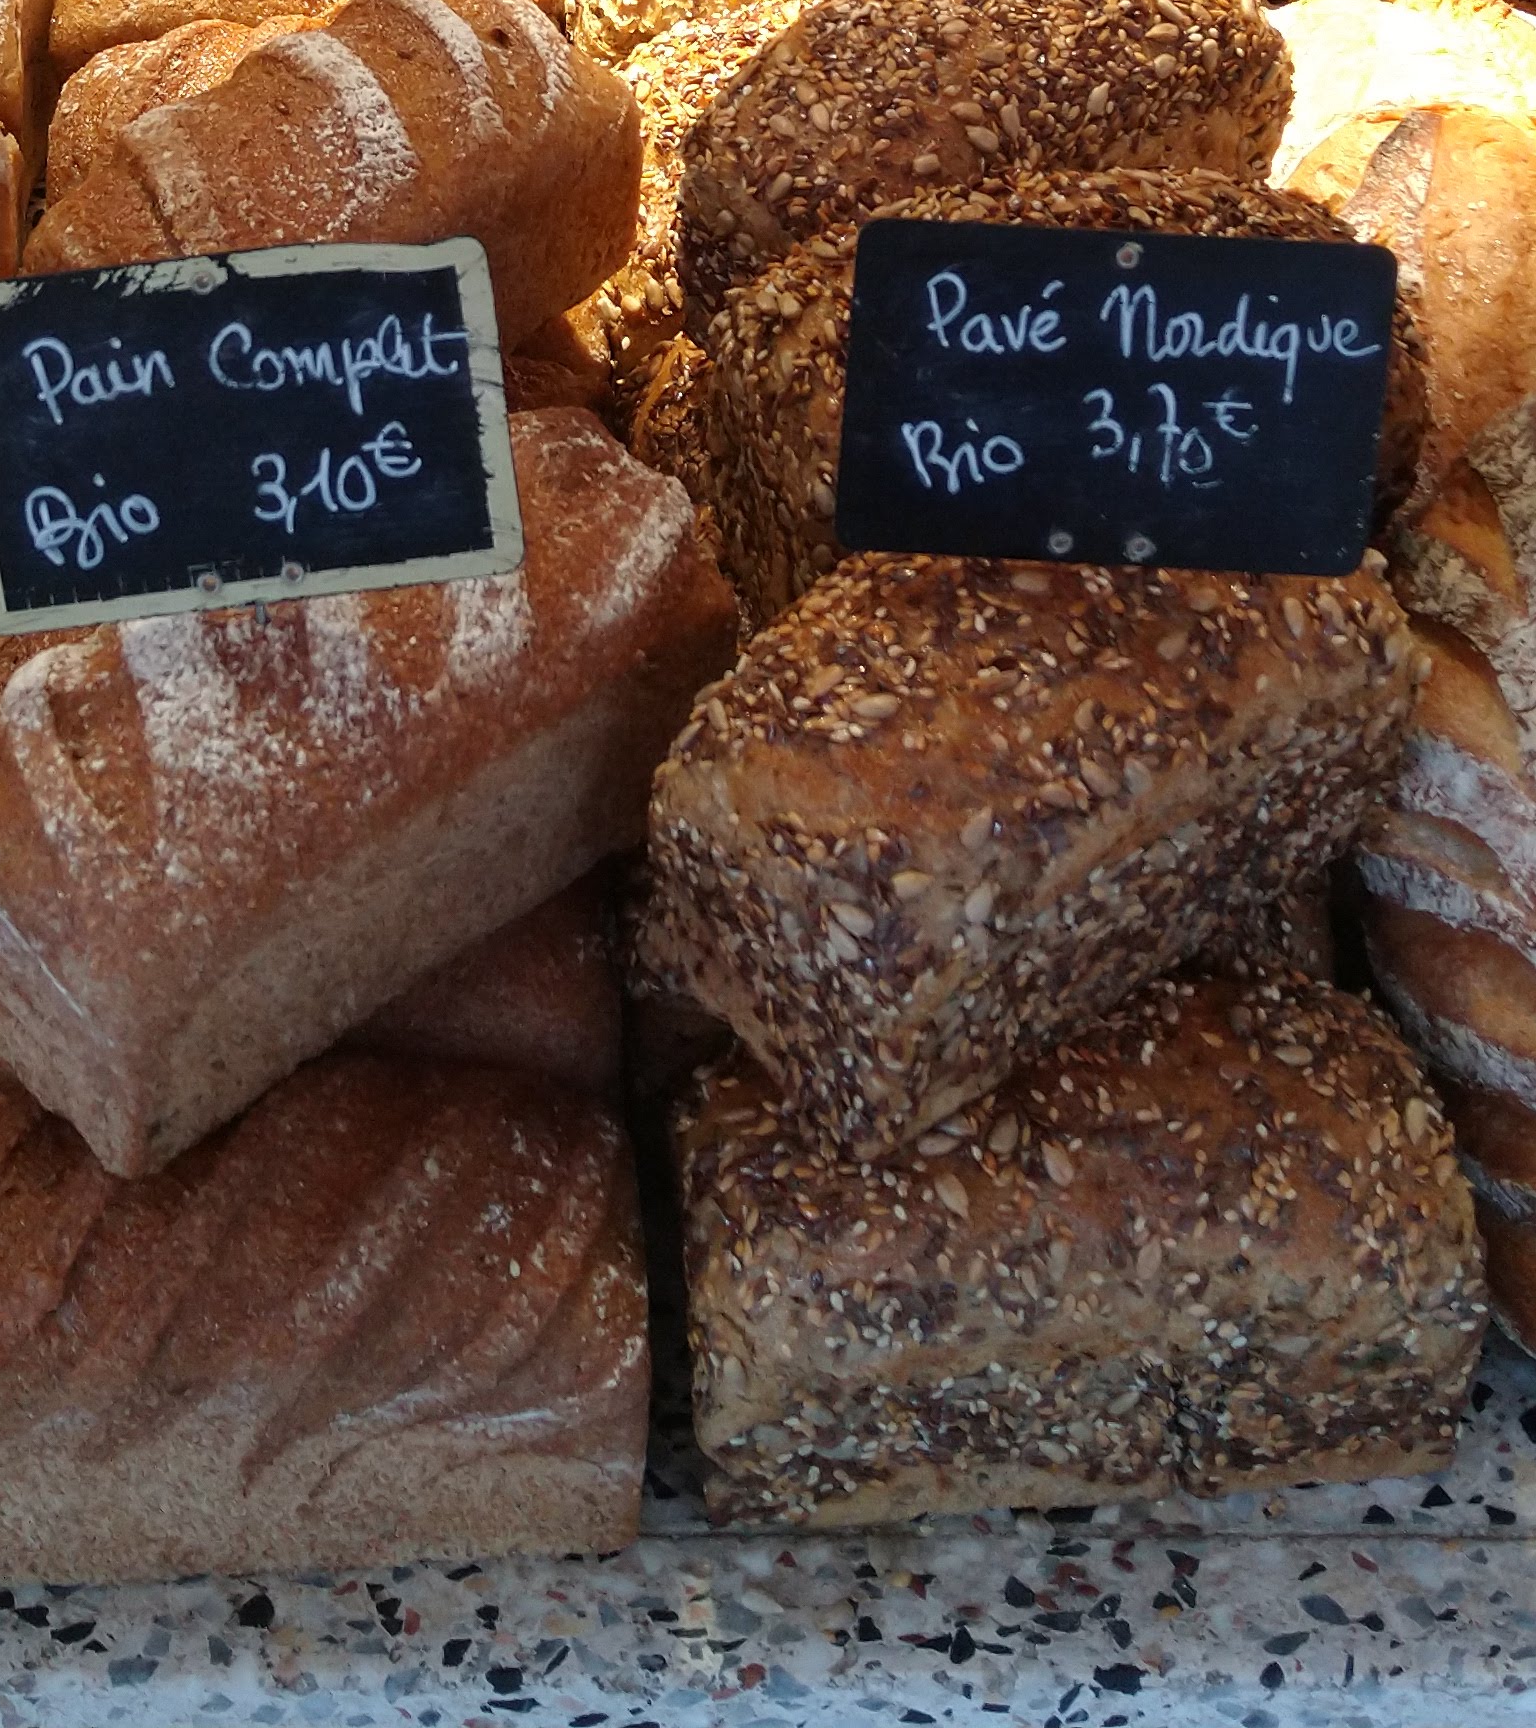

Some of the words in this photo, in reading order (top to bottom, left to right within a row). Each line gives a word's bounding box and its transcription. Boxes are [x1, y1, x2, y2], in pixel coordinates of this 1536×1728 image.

[22, 336, 176, 425] Pain
[208, 313, 471, 415] Complet
[926, 271, 1066, 355] Pavé
[1099, 282, 1382, 405] Nordique
[901, 419, 1025, 494] Bio
[25, 472, 161, 570] Bio
